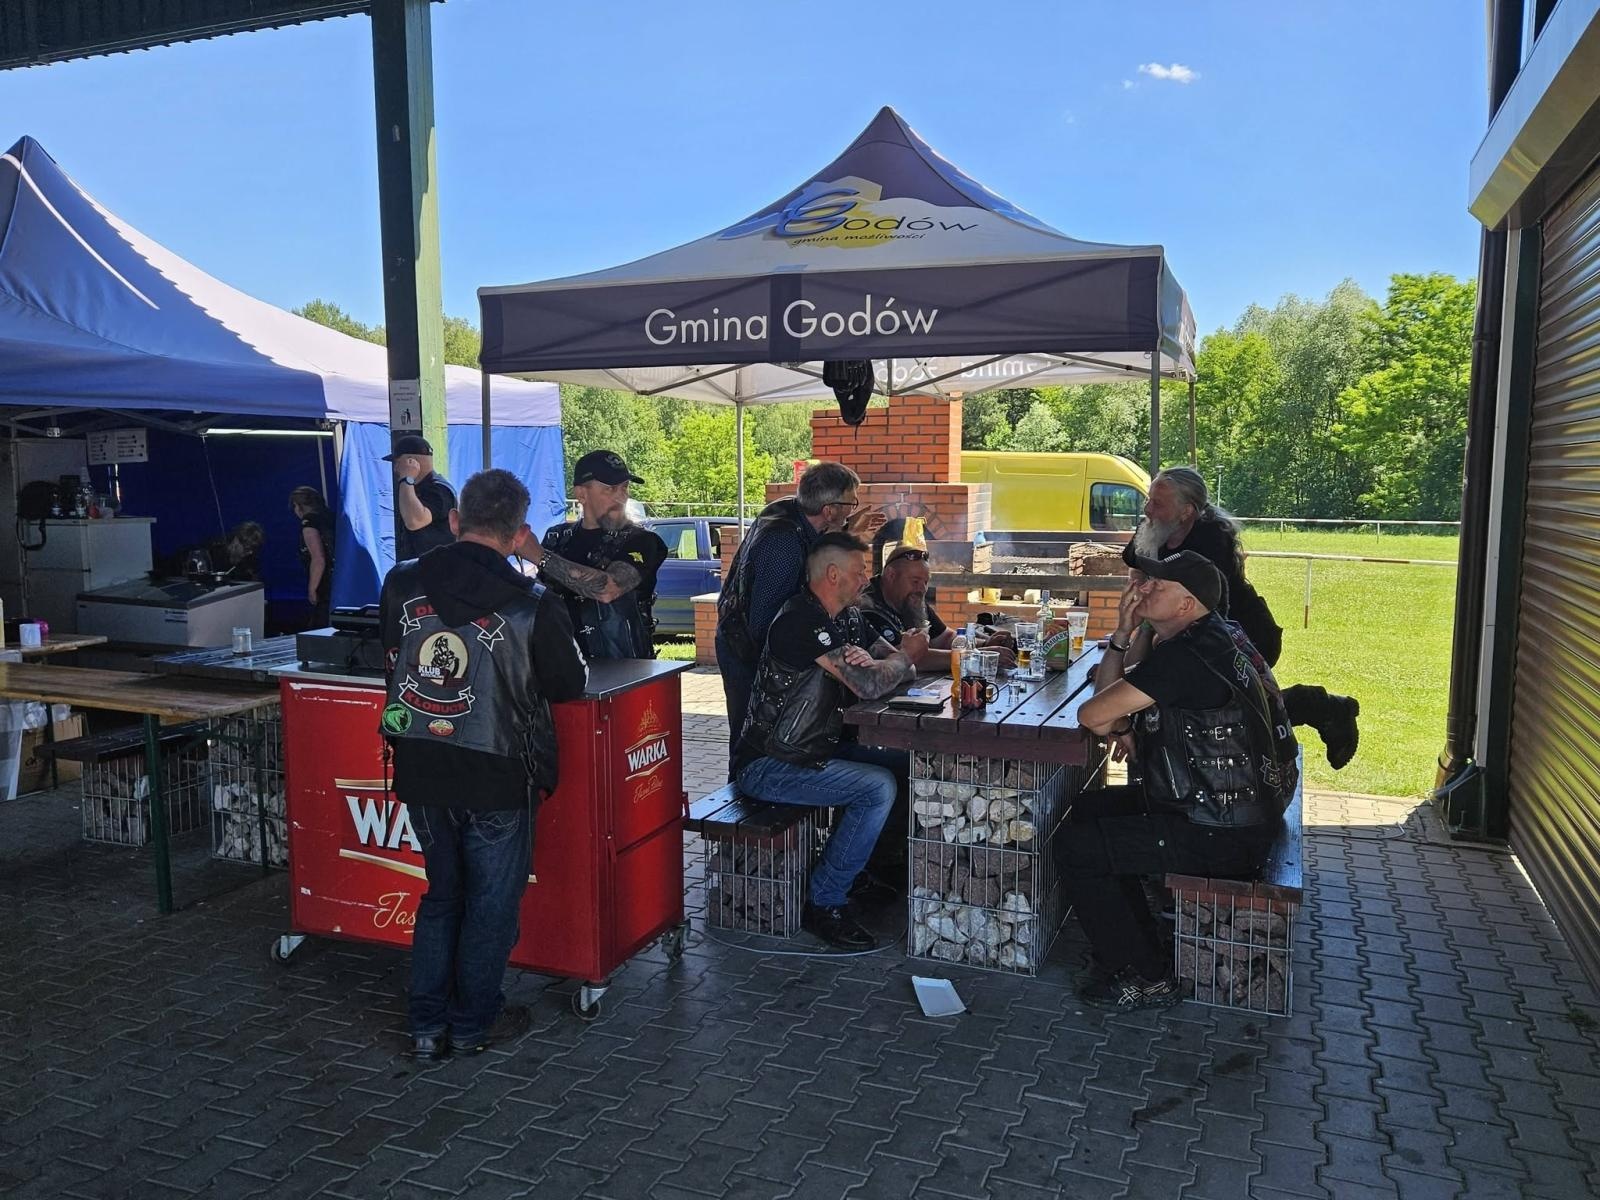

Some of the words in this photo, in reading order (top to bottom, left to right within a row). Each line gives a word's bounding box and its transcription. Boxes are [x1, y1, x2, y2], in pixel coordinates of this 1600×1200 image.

[776, 188, 979, 237] Godów
[792, 233, 839, 246] gmina
[844, 230, 927, 241] możliwości
[645, 308, 768, 345] Gmina
[783, 294, 938, 338] Godów
[418, 665, 441, 676] KLUB
[627, 739, 668, 773] WARKA
[345, 795, 422, 852] WA
[373, 891, 416, 928] Jas
